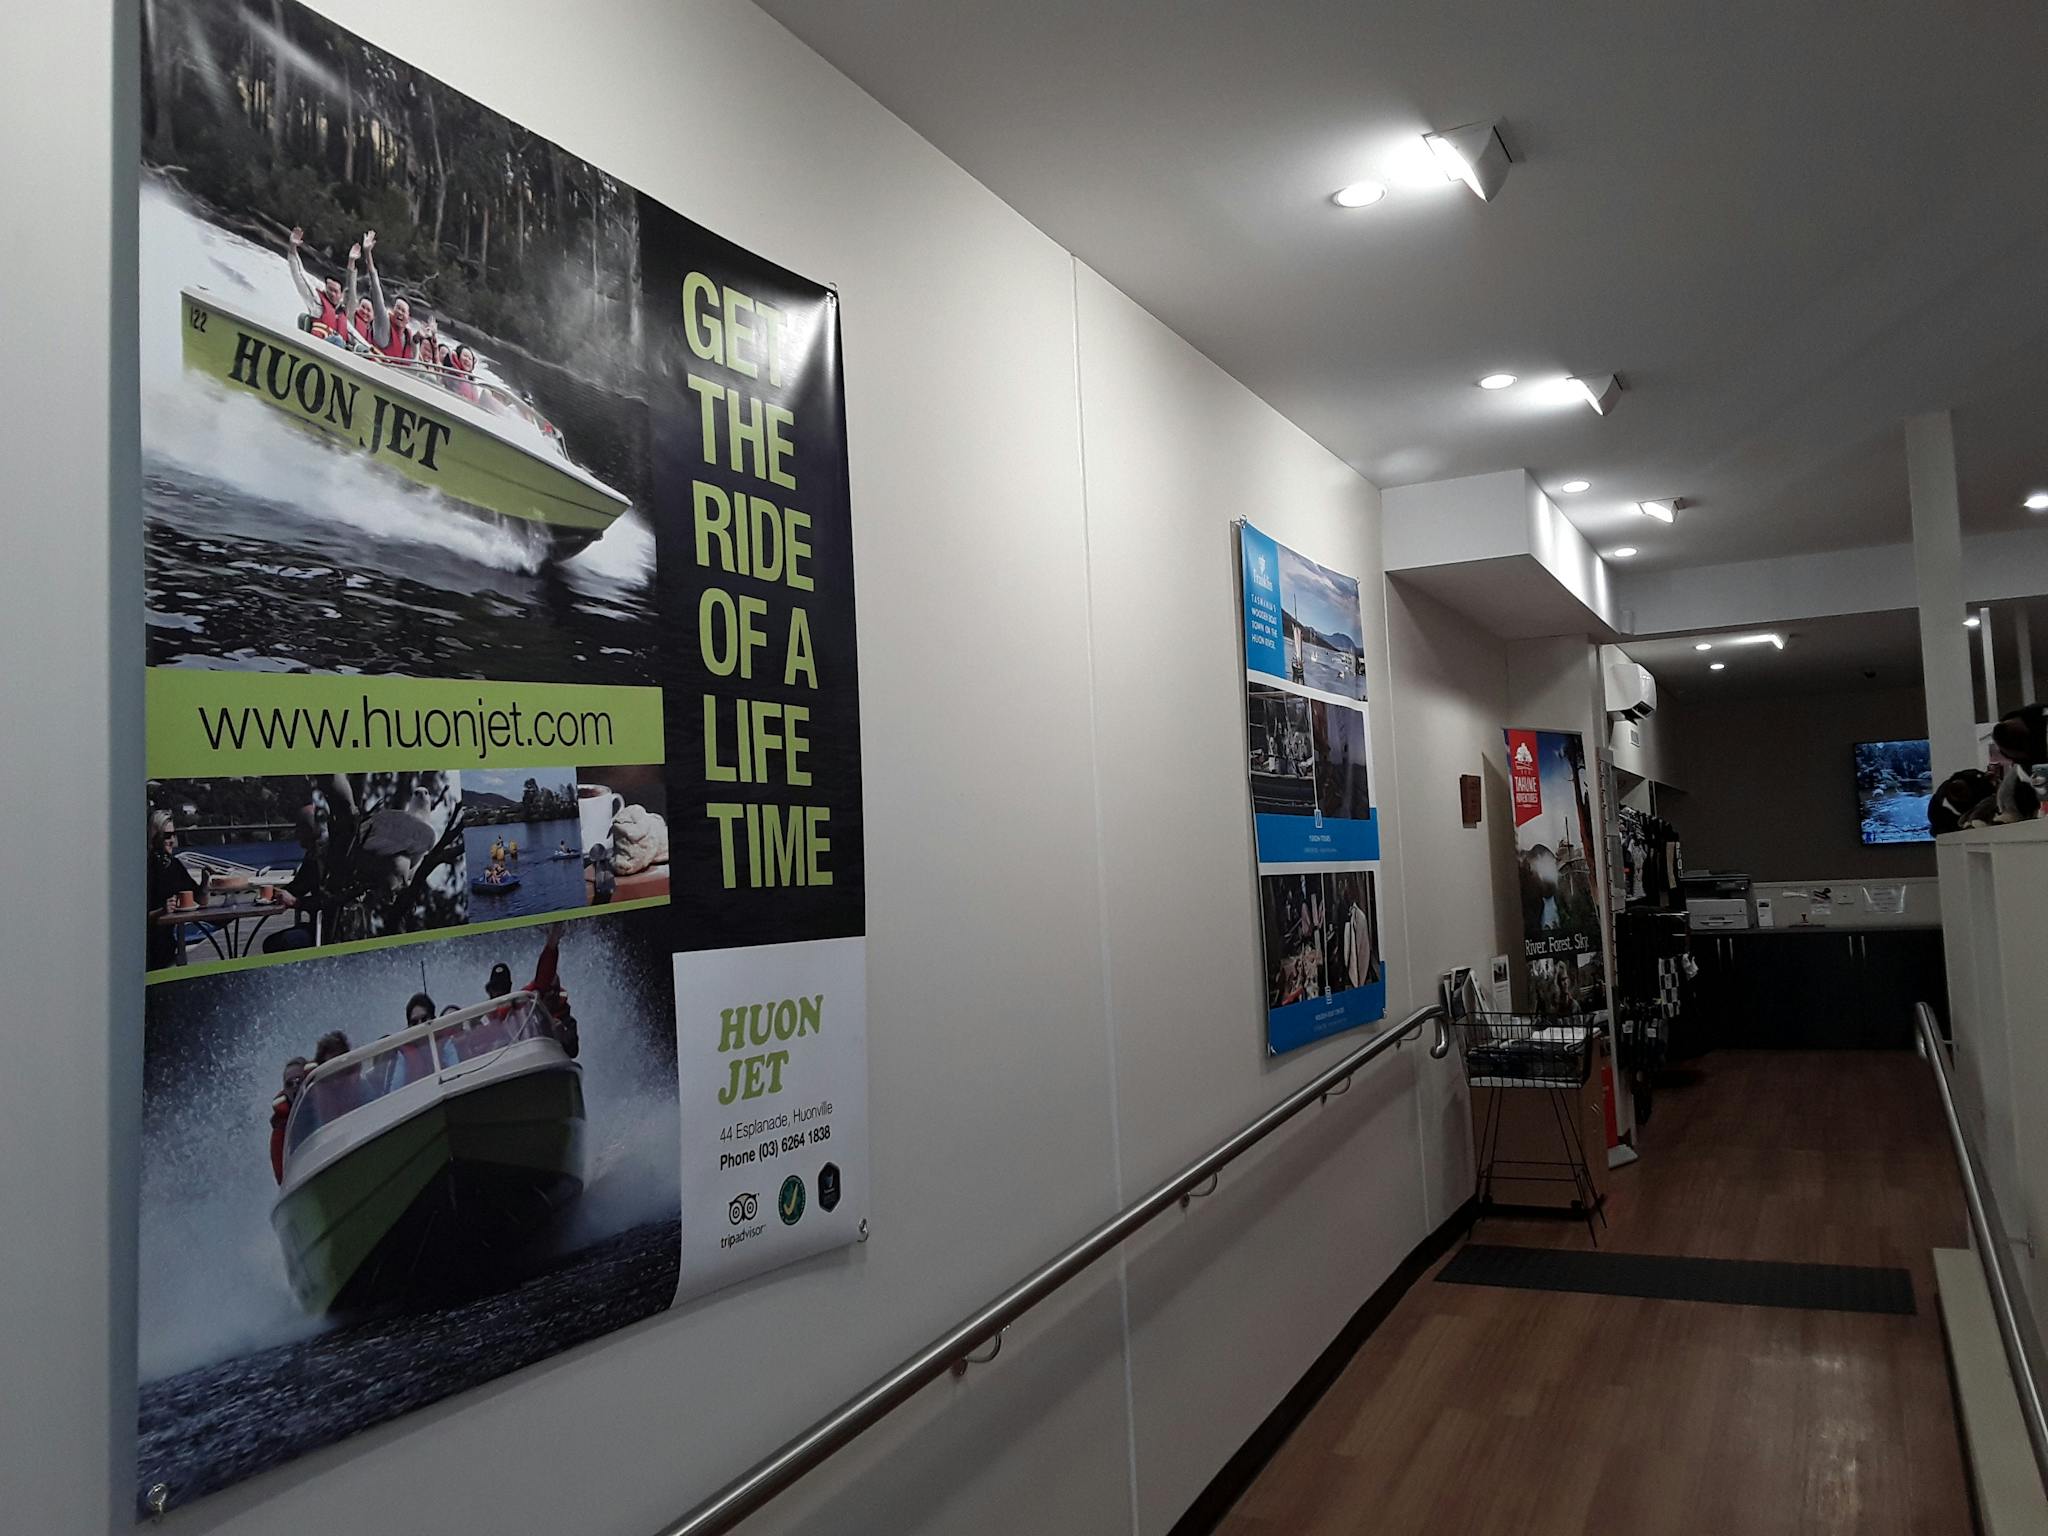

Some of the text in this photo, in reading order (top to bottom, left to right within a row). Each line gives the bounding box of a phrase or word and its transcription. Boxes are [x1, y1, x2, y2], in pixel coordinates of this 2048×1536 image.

[682, 271, 788, 388] GET
[228, 332, 451, 472] HUON JET
[687, 373, 797, 491] THE
[692, 479, 815, 592] RIDE
[699, 587, 818, 689] OF A
[198, 695, 613, 760] www.huonjet.com
[703, 694, 813, 786] LIFE
[706, 802, 833, 889] TIME
[717, 994, 824, 1053] HUON
[718, 1050, 789, 1105] JET
[719, 1101, 833, 1143] 44 Esplanade, Huonville
[720, 1125, 831, 1171] Phone (03) 6264 1838
[720, 1224, 766, 1249] tripadvisor
